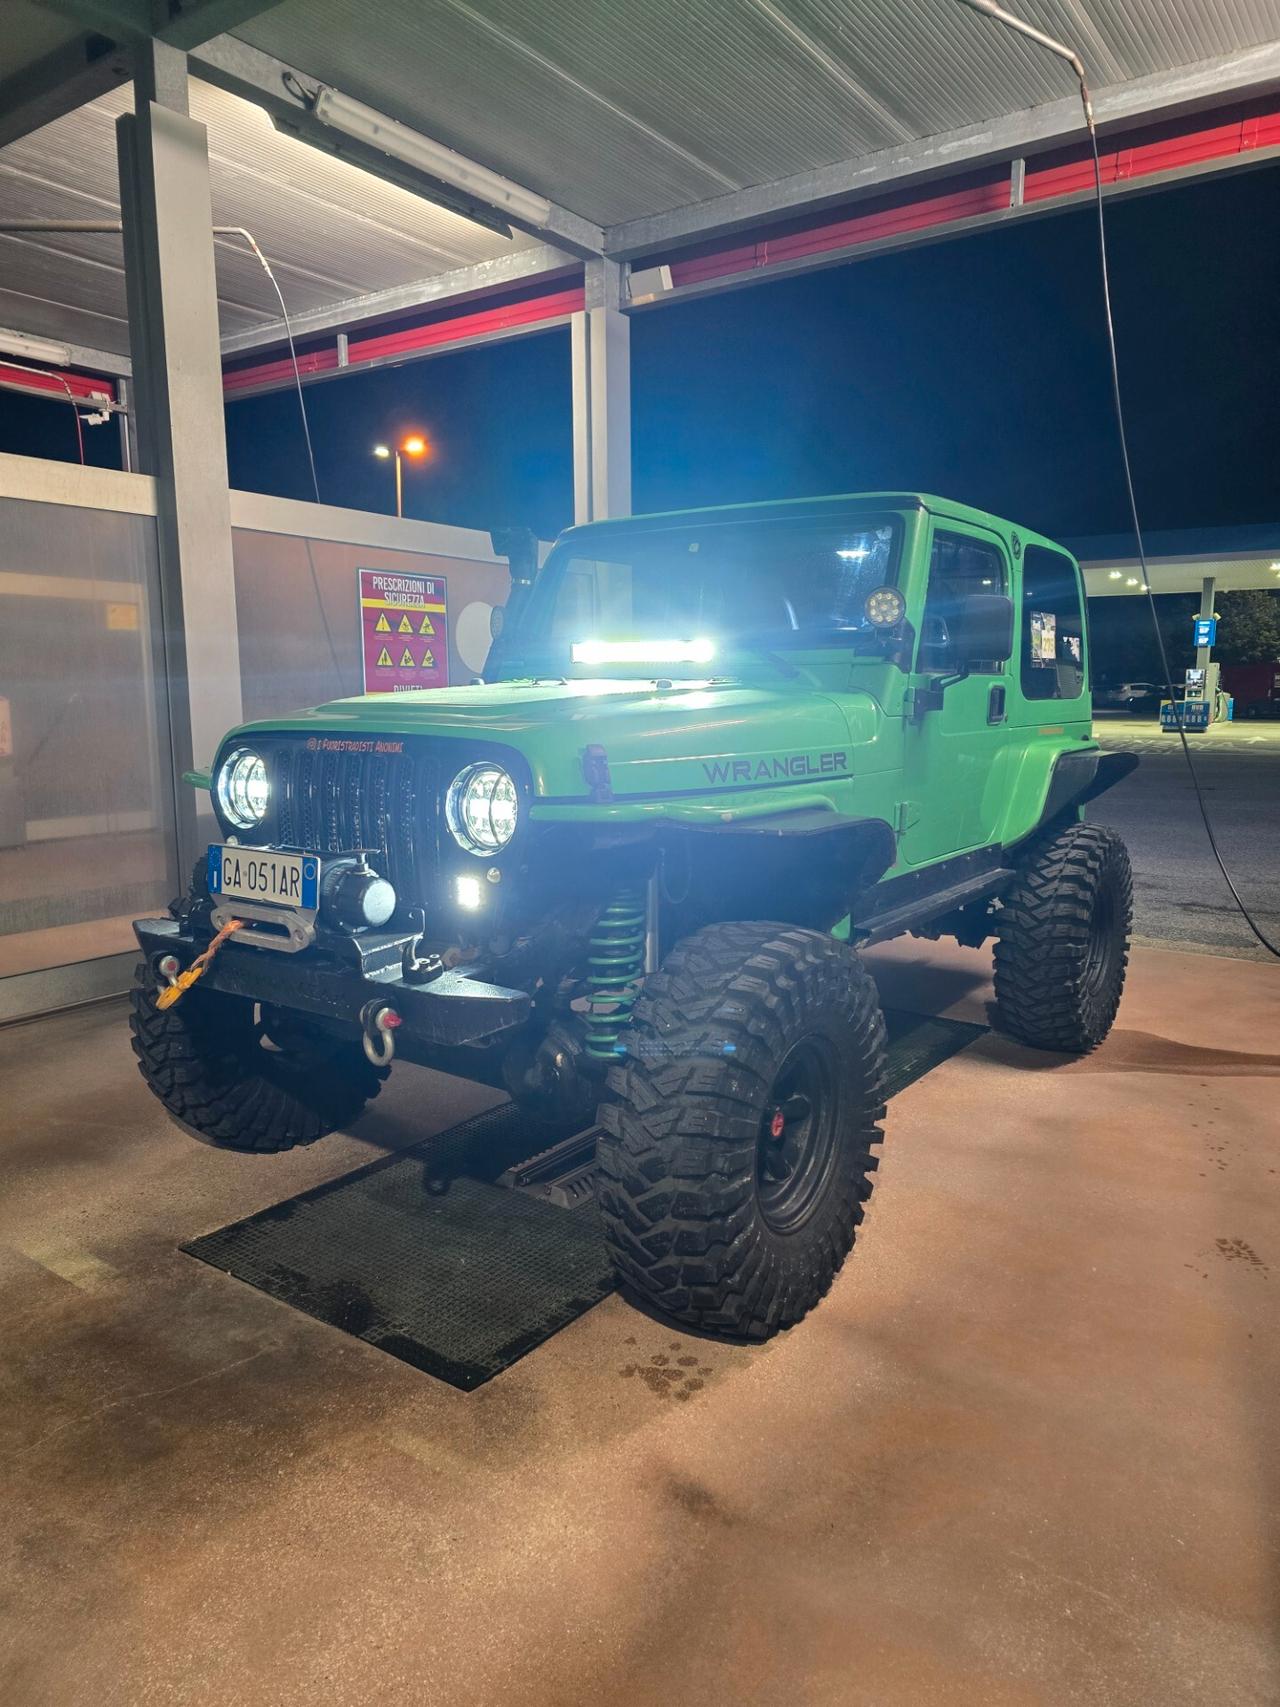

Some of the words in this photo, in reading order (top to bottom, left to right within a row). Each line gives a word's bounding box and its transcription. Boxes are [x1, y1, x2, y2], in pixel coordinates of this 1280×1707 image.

[373, 576, 425, 594] PRESCRIZIONI
[426, 581, 435, 595] DI
[384, 591, 425, 608] SICUREZZA
[702, 752, 847, 784] WRANGLER
